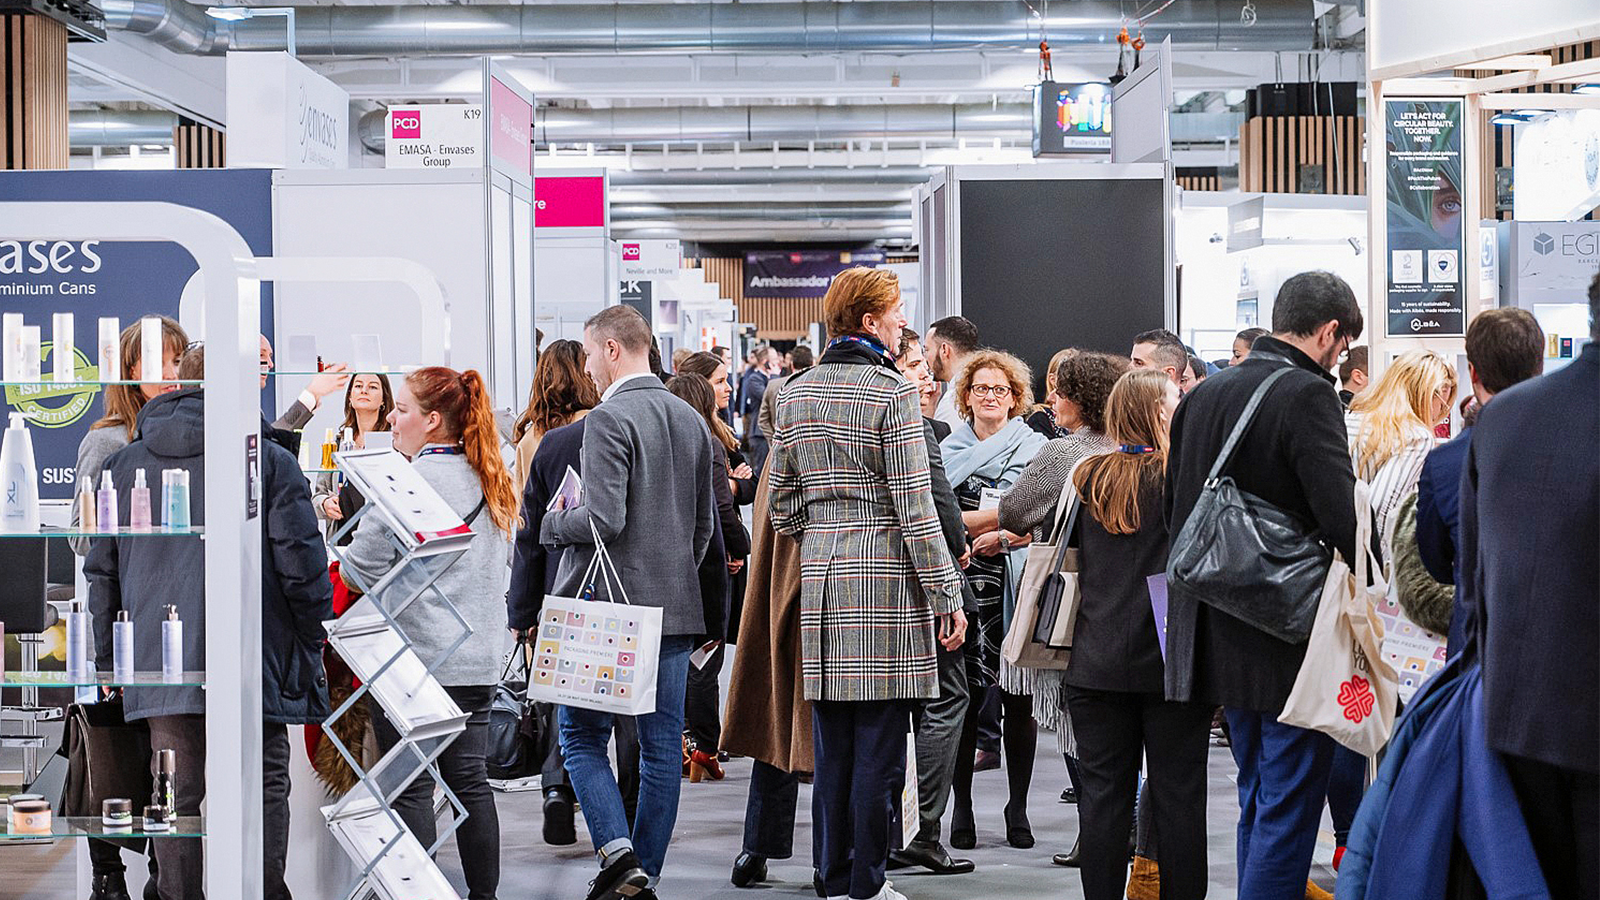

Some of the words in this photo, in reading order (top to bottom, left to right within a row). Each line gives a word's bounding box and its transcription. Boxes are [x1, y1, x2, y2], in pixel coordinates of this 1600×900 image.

[464, 109, 481, 120] K19
[393, 118, 419, 130] PCD
[400, 144, 432, 155] EMASA
[440, 144, 474, 155] Envases
[423, 156, 451, 168] Group
[0, 240, 102, 274] ases
[750, 275, 830, 288] Ambassador
[59, 282, 96, 295] Cans
[26, 398, 85, 421] CERTIFIED
[42, 468, 76, 484] SUS
[7, 481, 15, 504] XL
